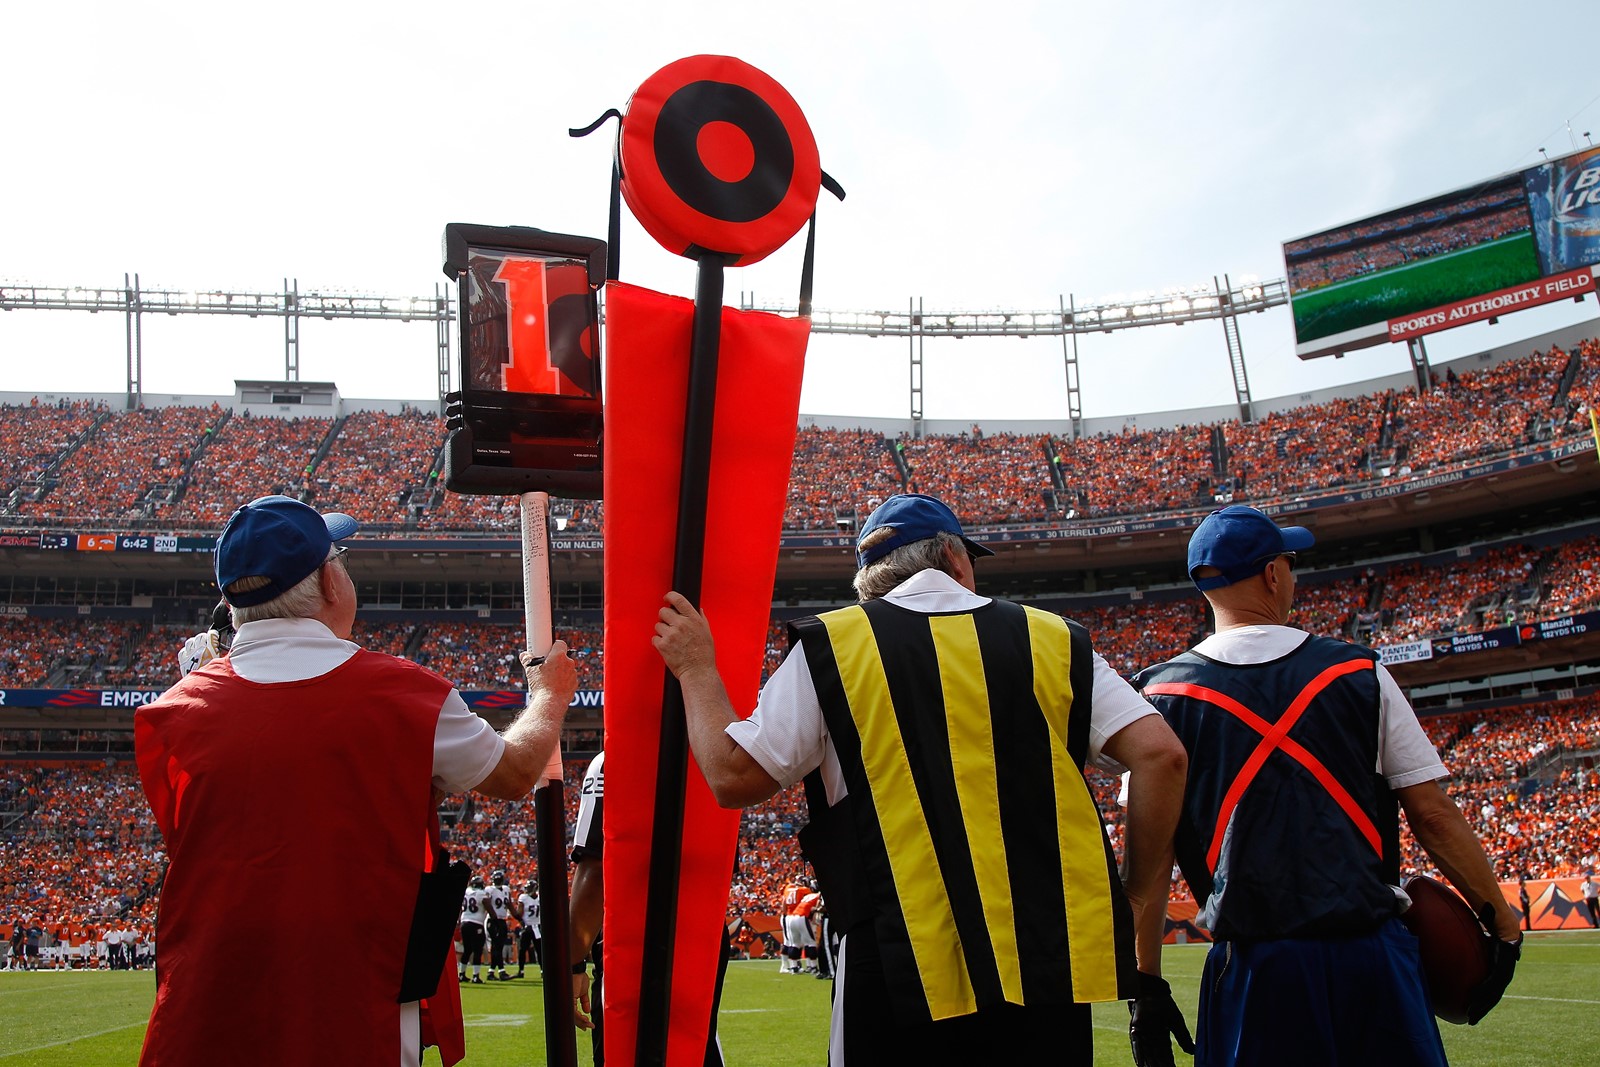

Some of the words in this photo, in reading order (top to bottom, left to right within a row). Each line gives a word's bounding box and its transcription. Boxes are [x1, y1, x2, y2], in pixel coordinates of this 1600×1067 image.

[1391, 312, 1446, 335] SPORTS
[1449, 286, 1540, 320] AUTHORITY
[1545, 274, 1590, 294] FIELD
[491, 255, 560, 395] 1
[1551, 447, 1563, 459] 77
[1567, 439, 1594, 454] KARL
[1375, 484, 1401, 498] GARY
[1404, 471, 1463, 493] ZIMMERMAN
[1047, 531, 1057, 539] 30
[1058, 527, 1098, 539] TERRELL
[1100, 525, 1126, 535] DAVIS
[0, 536, 40, 546] GMC
[60, 538, 68, 547] 3
[87, 538, 95, 547] 6
[122, 538, 148, 549] 6:42
[551, 541, 571, 549] TOM
[573, 541, 604, 549] NALEN
[839, 538, 850, 546] 84
[1540, 616, 1574, 631] Manziel
[1382, 643, 1423, 656] FANTASY
[1382, 653, 1410, 664] STATS
[1417, 650, 1430, 658] QB
